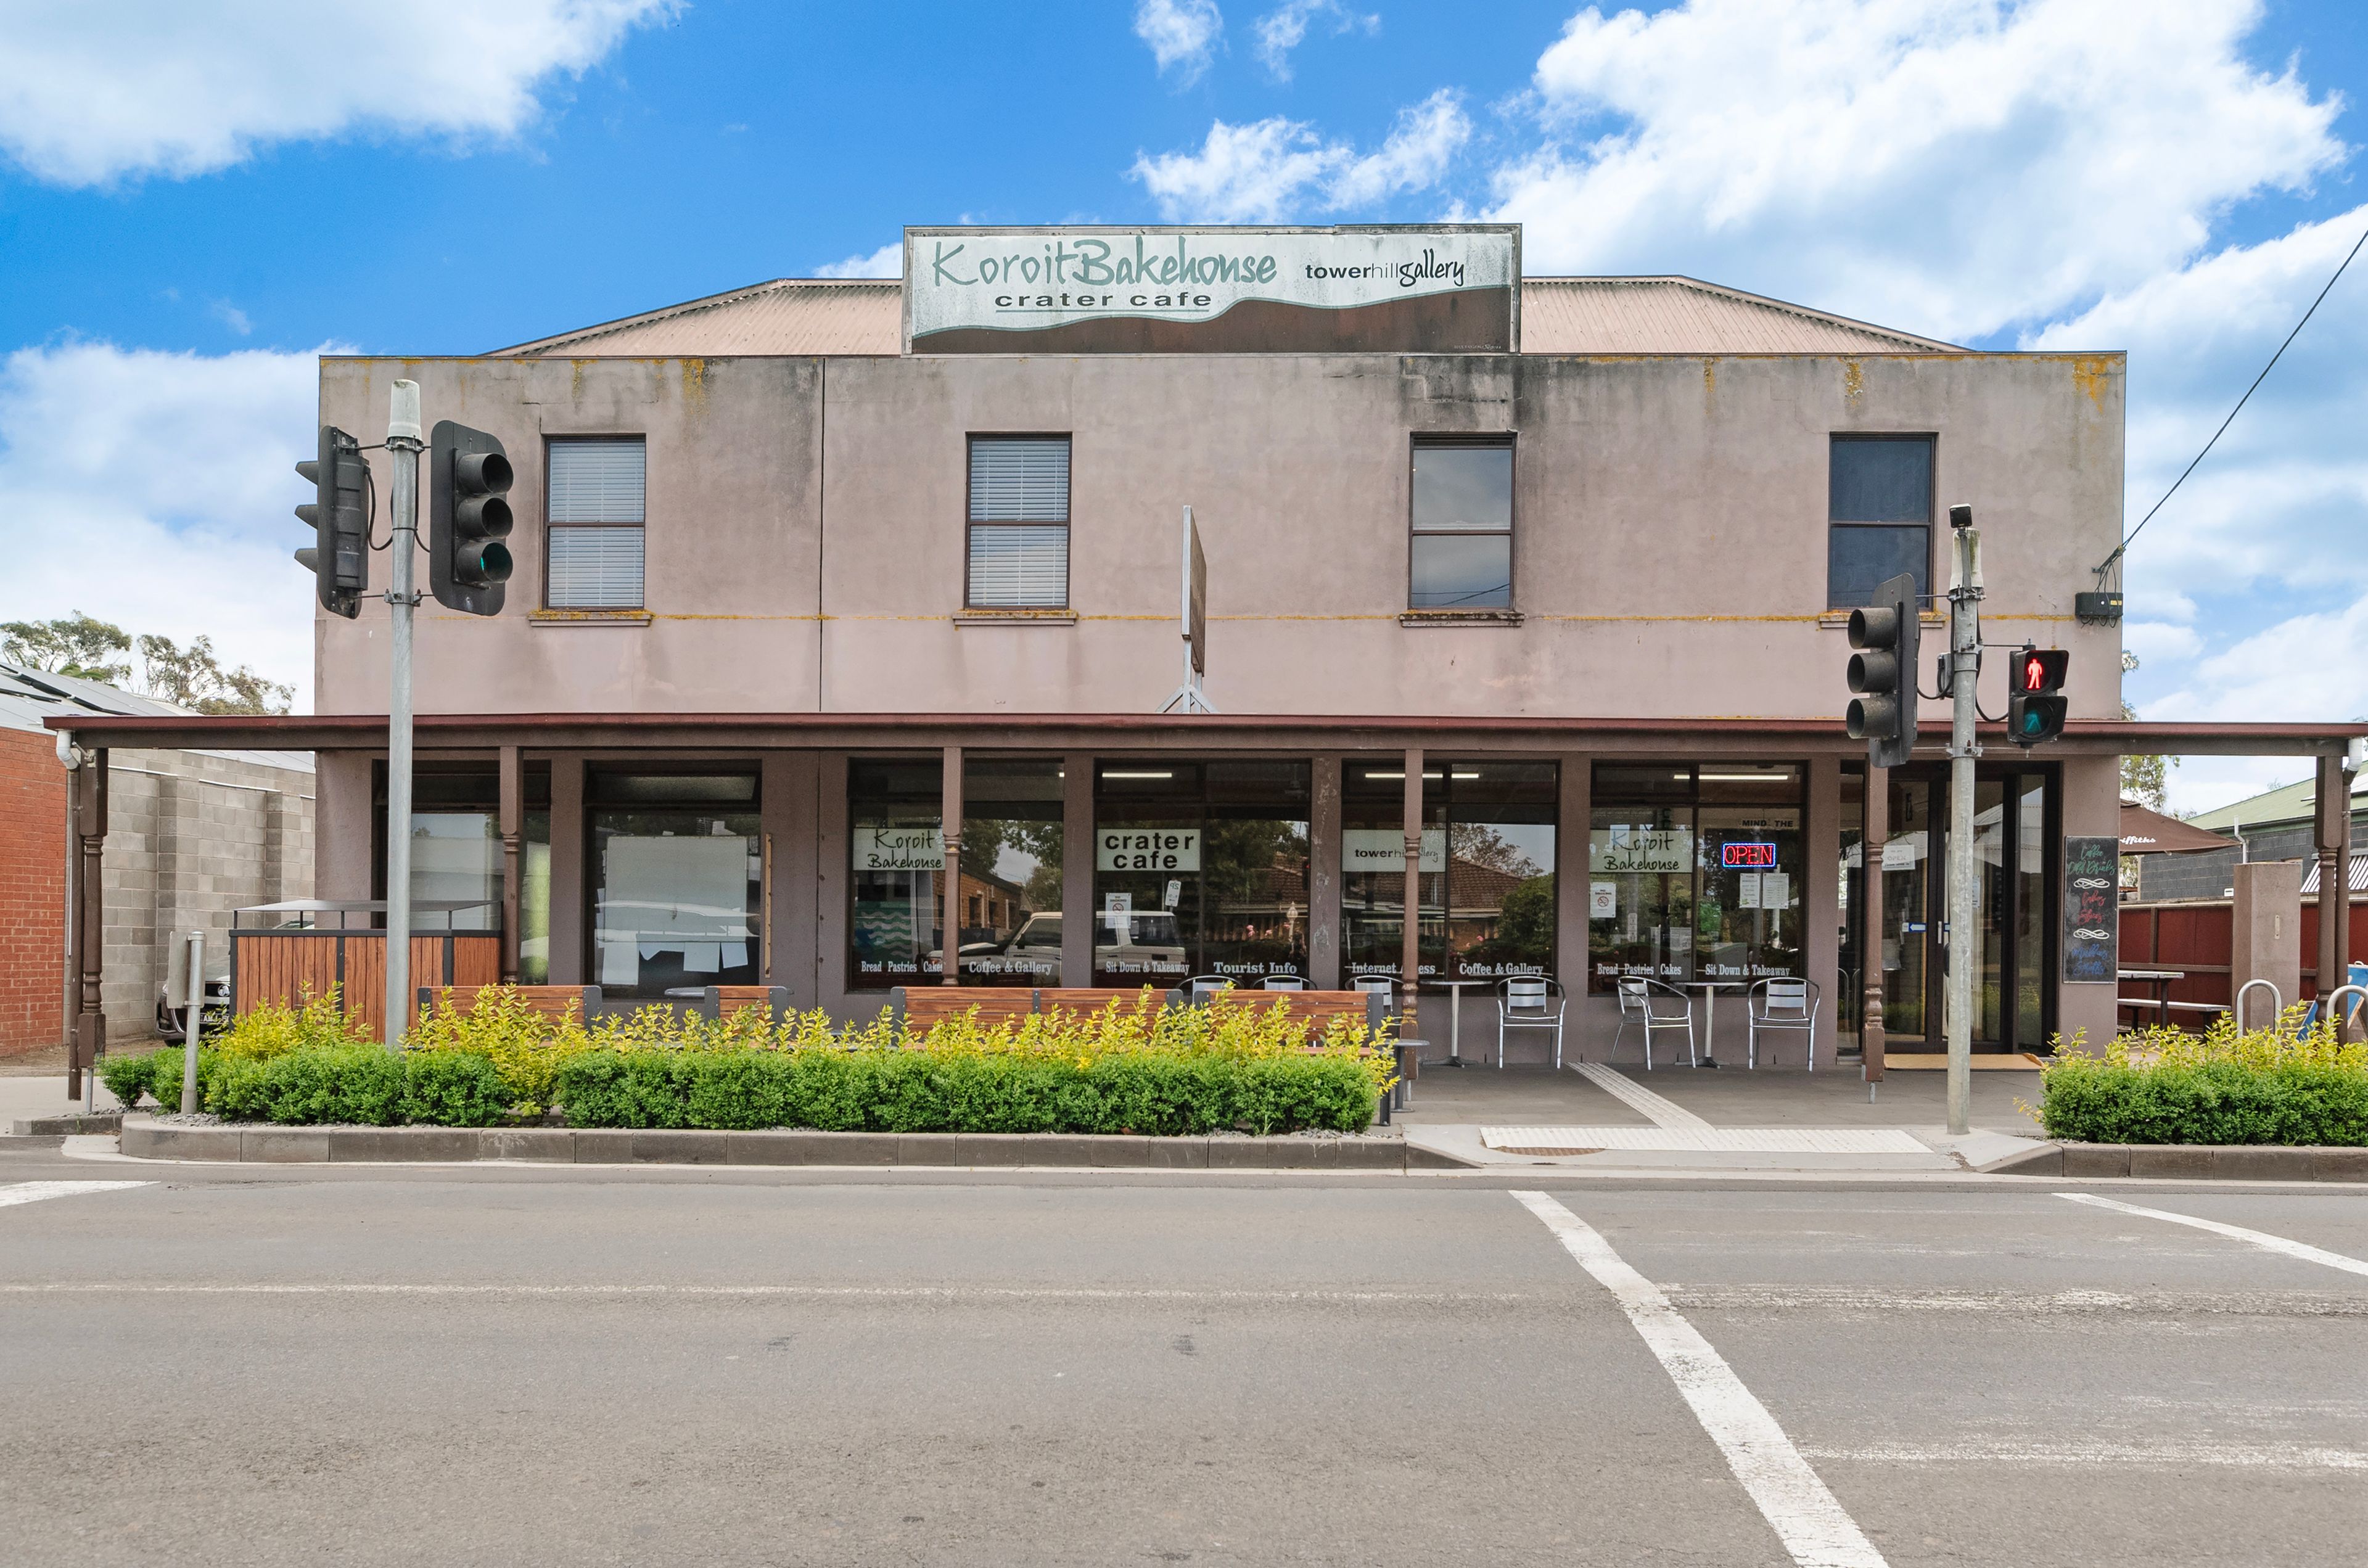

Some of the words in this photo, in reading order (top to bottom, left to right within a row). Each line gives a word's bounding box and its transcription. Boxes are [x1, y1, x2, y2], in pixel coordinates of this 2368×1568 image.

[995, 293, 1112, 306] crater
[1130, 292, 1211, 306] cafe
[874, 829, 934, 848] Koroit
[1105, 832, 1194, 850] crater
[1611, 831, 1674, 850] Koroit
[2119, 835, 2156, 845] iffiths
[868, 849, 942, 868] Bakehouse
[1113, 850, 1178, 869] cafe
[1604, 851, 1679, 870] Bakehouse
[1724, 845, 1773, 864] OPEN
[861, 961, 882, 972] Bread
[888, 961, 917, 972] Pastries
[969, 961, 1001, 973] Coffee
[1005, 961, 1013, 973] &
[1014, 961, 1052, 975] Gallery
[1106, 961, 1117, 972] Sit
[1119, 961, 1141, 972] Down
[1143, 961, 1150, 972] &
[1151, 961, 1190, 976] Takeaway
[1213, 961, 1265, 974] Tourist
[1269, 962, 1297, 974] Info
[1352, 962, 1397, 974] Internet
[1459, 963, 1492, 974] Coffee
[1495, 963, 1504, 974] &
[1505, 963, 1544, 977] Gallery
[1597, 963, 1619, 975] Bread
[1624, 963, 1654, 975] Pastries
[1660, 963, 1682, 975] Cakes
[1705, 963, 1717, 975] Sit
[1719, 964, 1741, 975] Down
[1742, 964, 1749, 975] &
[1751, 964, 1790, 977] Takeaway
